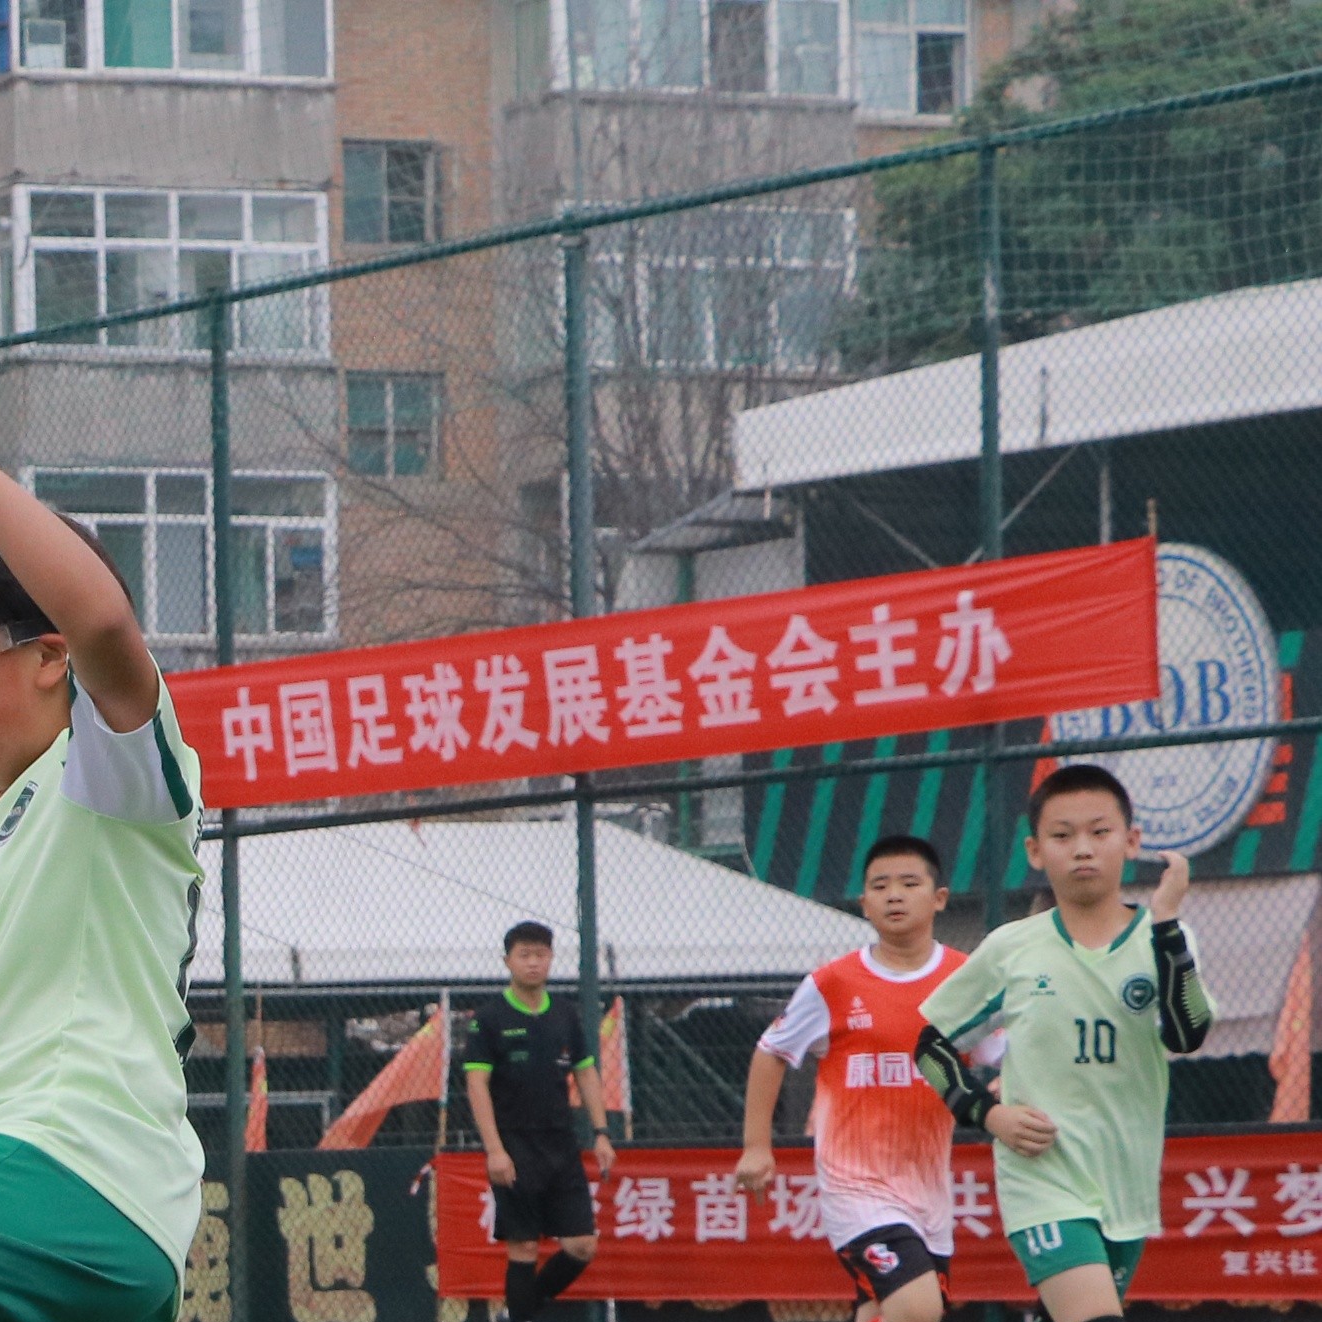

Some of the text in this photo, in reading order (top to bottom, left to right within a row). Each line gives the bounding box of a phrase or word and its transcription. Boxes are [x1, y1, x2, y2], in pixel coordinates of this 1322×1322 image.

[220, 589, 1012, 784] 中国足球发展基金会主办
[1073, 1018, 1117, 1064] 10
[1024, 1225, 1063, 1257] 10
